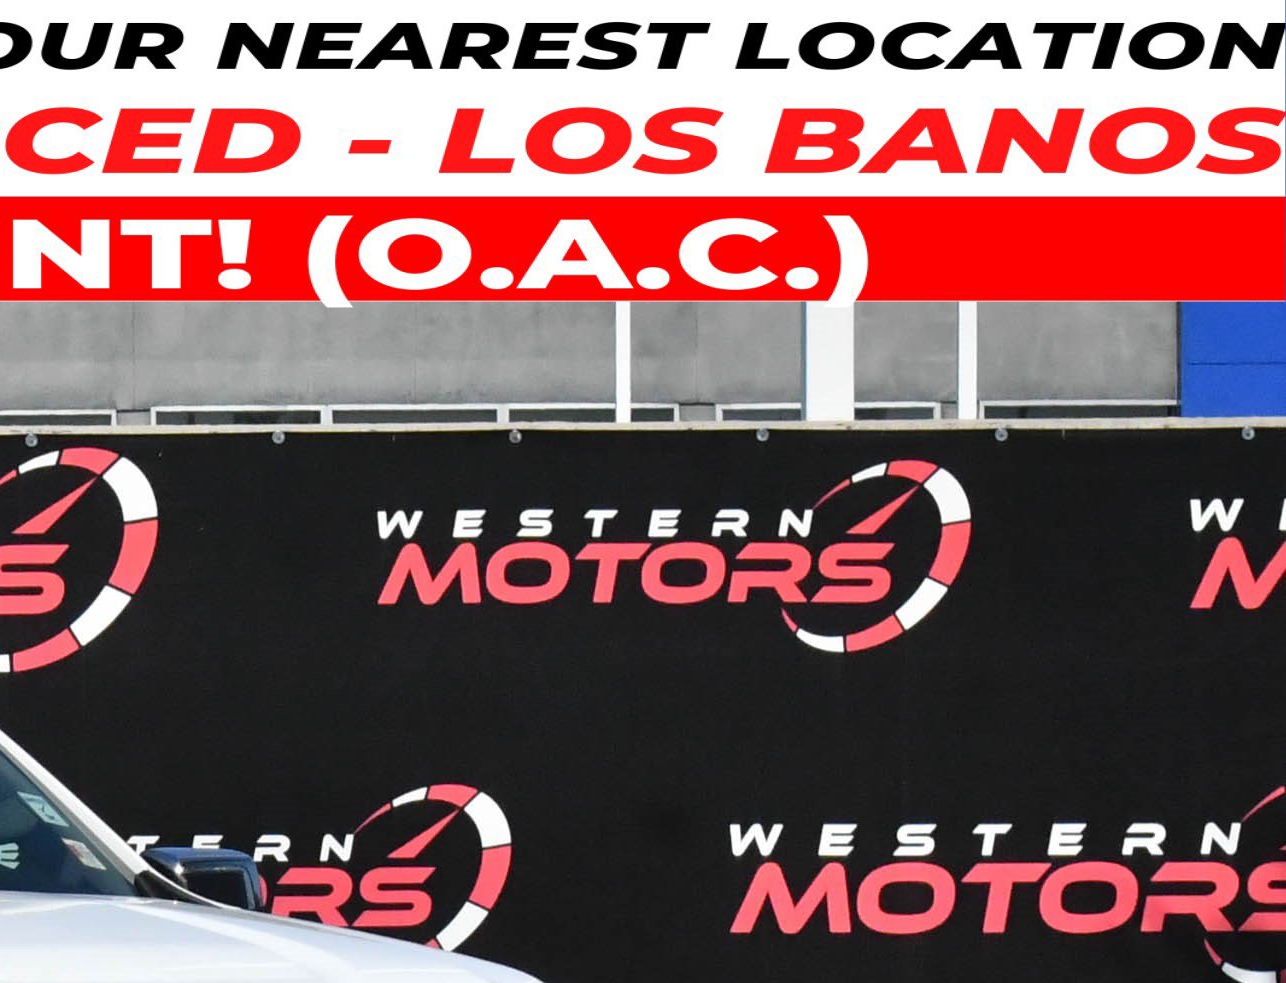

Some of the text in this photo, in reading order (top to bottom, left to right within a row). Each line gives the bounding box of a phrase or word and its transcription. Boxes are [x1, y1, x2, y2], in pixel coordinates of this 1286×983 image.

[377, 508, 814, 540] WESTERN
[377, 540, 896, 606] MOTORS
[729, 822, 1242, 857] WESTERN
